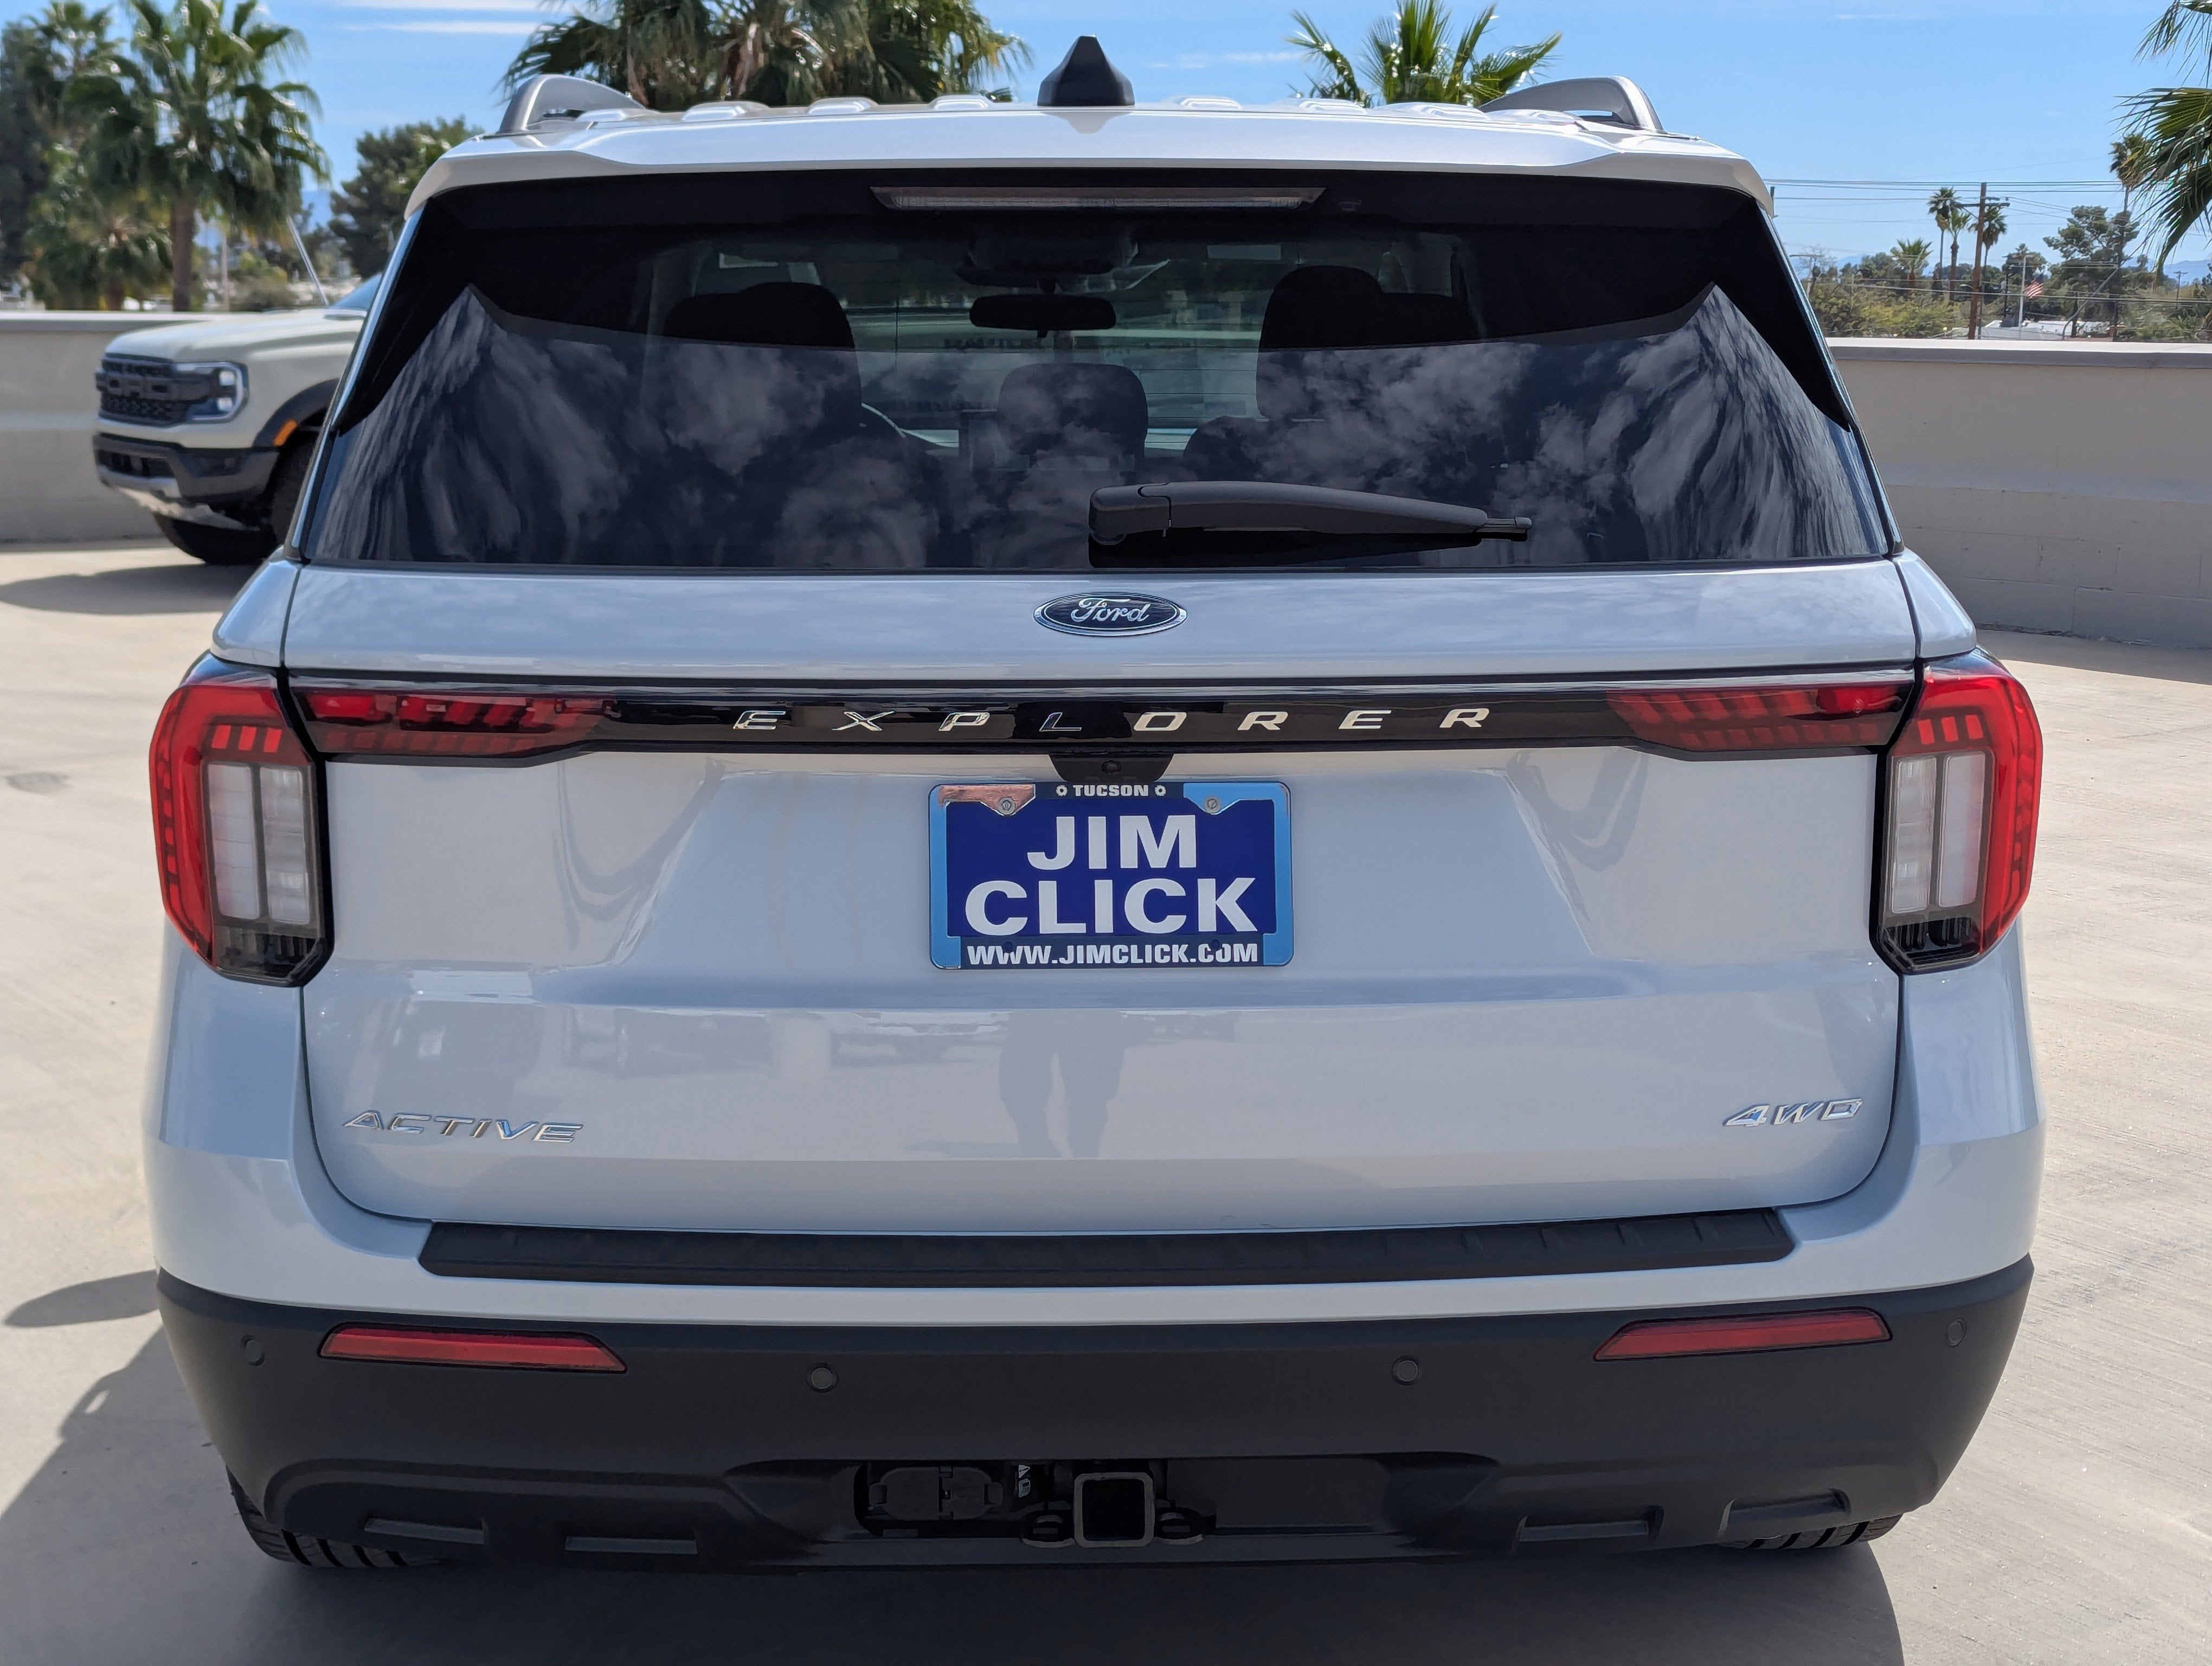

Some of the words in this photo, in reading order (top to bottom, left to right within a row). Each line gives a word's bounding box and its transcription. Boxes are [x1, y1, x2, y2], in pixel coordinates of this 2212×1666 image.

[1070, 597, 1151, 623] Ford
[732, 707, 1490, 732] EXPLORER
[1072, 784, 1149, 797] TUCSON
[1027, 814, 1197, 870] JIM
[964, 877, 1258, 936] CLICK
[967, 943, 1258, 965] WWW.JIMCLICK.COM
[1722, 1097, 1863, 1127] 4WD
[343, 1110, 583, 1143] ACTIVE
